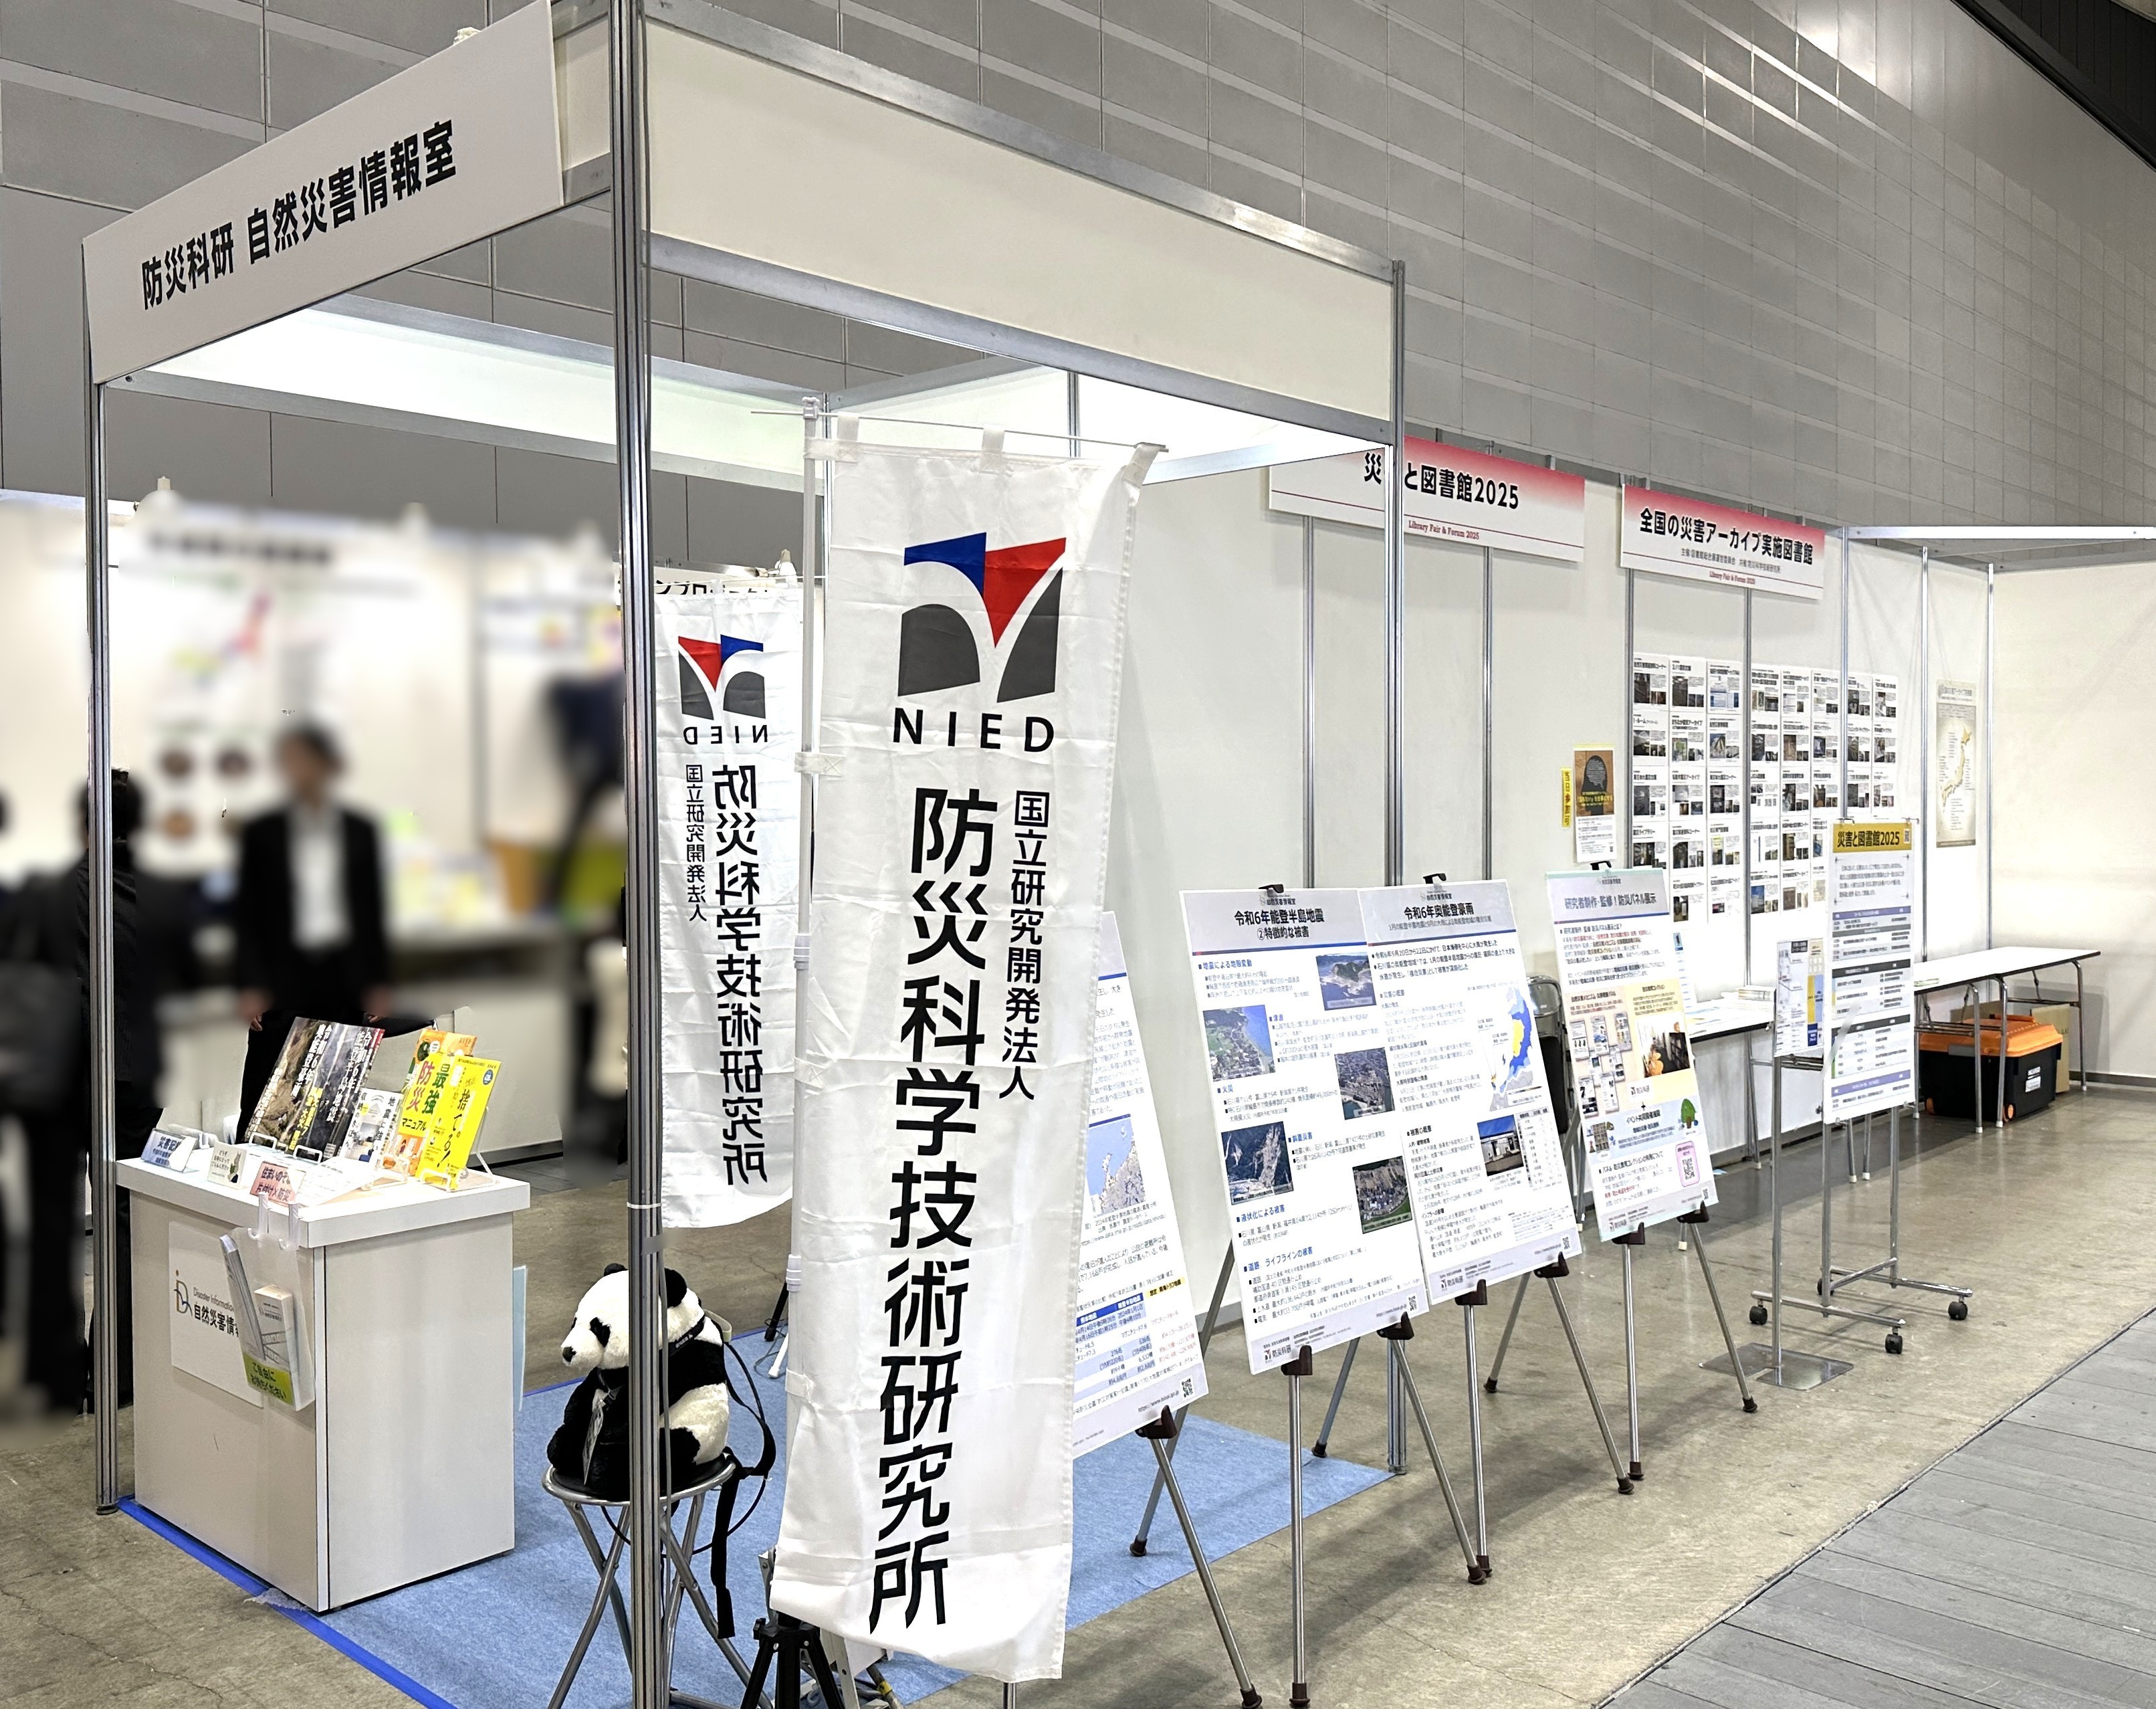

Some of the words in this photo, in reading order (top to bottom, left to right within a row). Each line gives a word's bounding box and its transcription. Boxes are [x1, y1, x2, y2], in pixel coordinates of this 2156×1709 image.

[141, 221, 234, 310] 防災科研
[247, 119, 456, 264] 自然災害情報室
[1364, 452, 1518, 510] 災と図書館2025
[1408, 520, 1428, 533] Library
[1429, 524, 1440, 533] Fair
[1447, 527, 1465, 537] Forum
[1466, 530, 1479, 539] 2025
[1640, 508, 1813, 565] 全国の災害アーカイブ実施図書館
[893, 707, 1055, 752] NIED
[1838, 831, 1900, 847] 災害と図書館2025
[1233, 907, 1325, 926] 令和6年能登半島地震
[1403, 902, 1474, 920] 令和6年奥能登豪雨
[999, 791, 1050, 1101] 国立研究開発法人
[405, 1061, 435, 1112] 防災
[421, 1063, 451, 1114] 最強
[402, 1118, 427, 1131] マニュアル
[870, 787, 998, 1635] 防災科学技術研究所
[193, 1287, 211, 1302] Disaster
